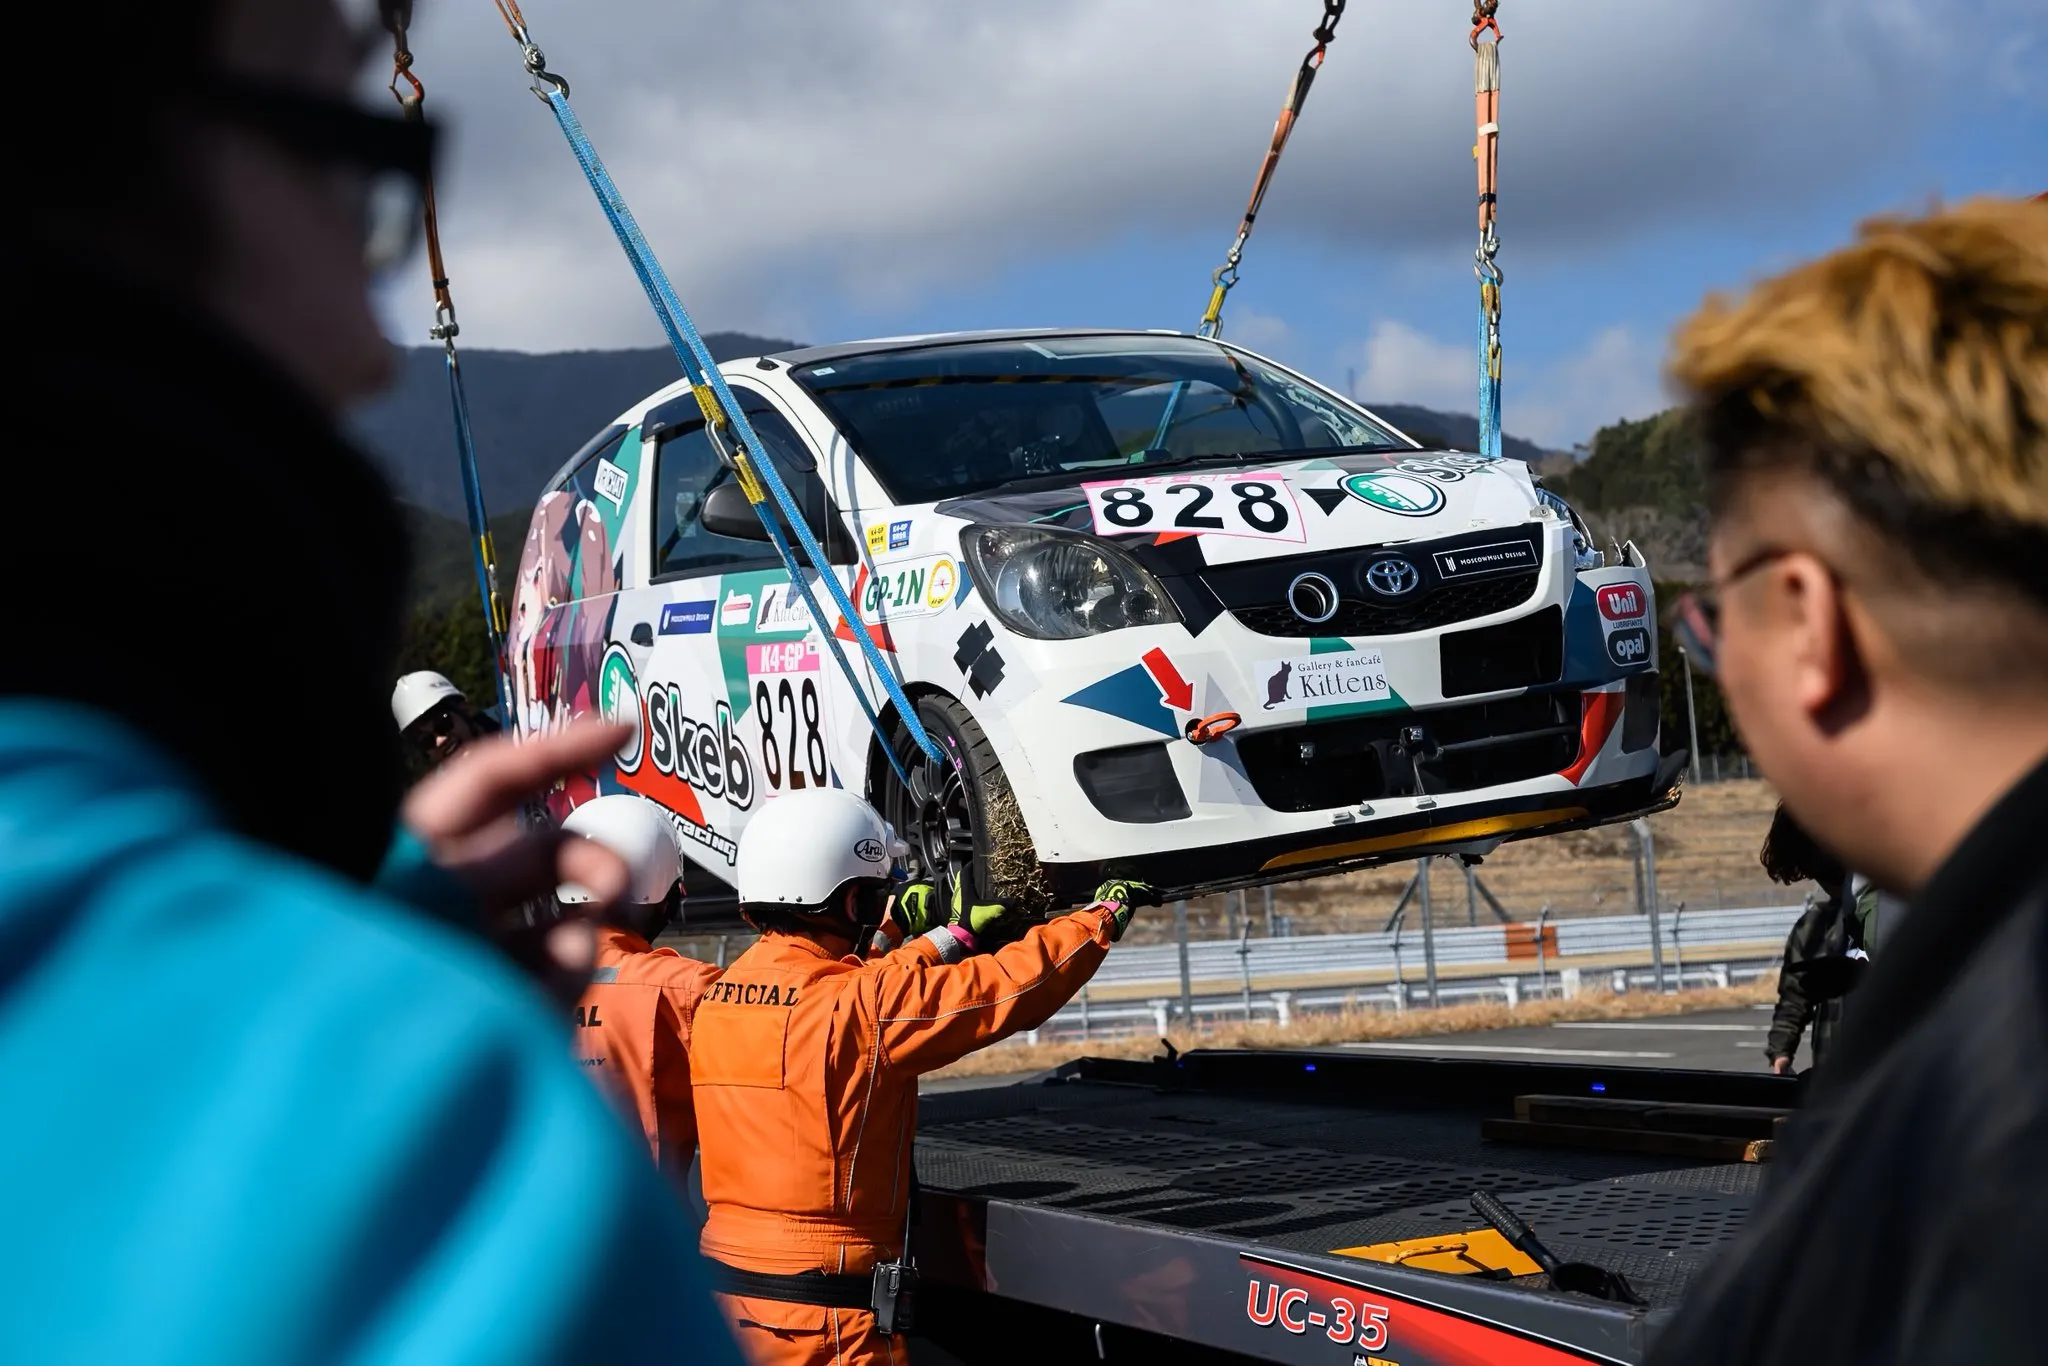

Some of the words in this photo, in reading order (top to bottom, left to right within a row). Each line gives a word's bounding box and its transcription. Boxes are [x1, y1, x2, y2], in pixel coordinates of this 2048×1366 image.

[1100, 482, 1289, 533] 828
[1460, 553, 1504, 566] MOSCOWMULE
[1505, 551, 1527, 559] DESIGN
[866, 568, 925, 612] GP-1N
[1607, 591, 1638, 615] Unil
[761, 642, 805, 673] K4-GP
[1616, 632, 1645, 660] opal
[1298, 661, 1332, 672] Gallery
[1335, 659, 1343, 668] &
[1346, 655, 1381, 667] fanCafé
[1299, 673, 1387, 698] Kittens
[648, 682, 754, 812] Skeb
[756, 678, 827, 790] 828
[1247, 1280, 1389, 1351] UC-35
